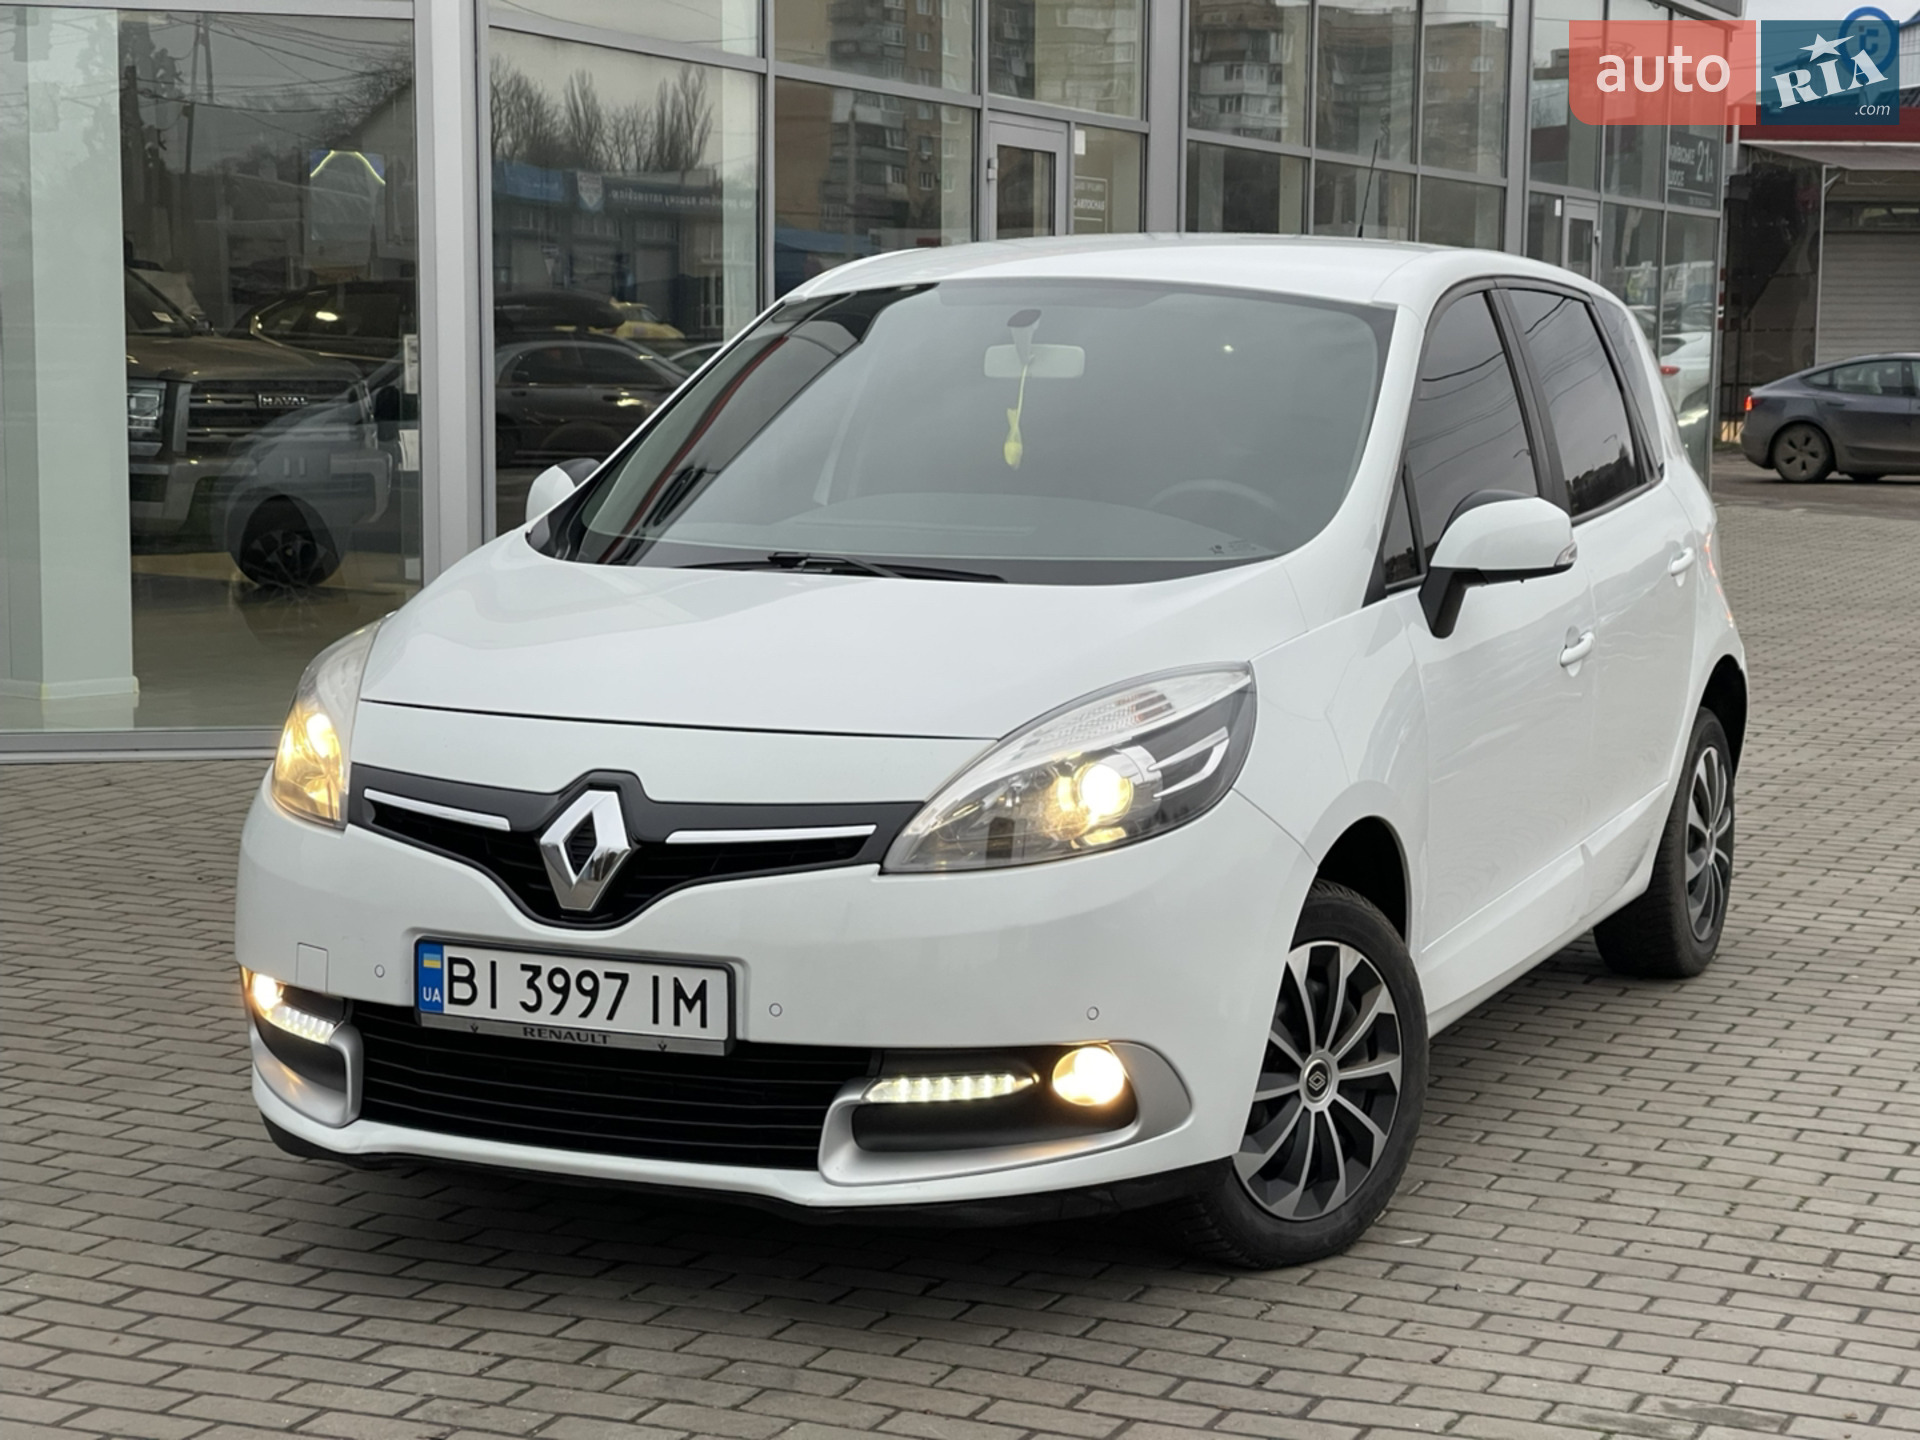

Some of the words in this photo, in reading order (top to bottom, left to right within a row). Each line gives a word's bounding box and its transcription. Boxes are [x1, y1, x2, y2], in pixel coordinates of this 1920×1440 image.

[262, 396, 308, 406] HAVAL
[423, 986, 441, 1003] UA
[447, 956, 497, 1010] BI
[519, 963, 630, 1021] 3997
[652, 975, 707, 1028] IM
[522, 1026, 611, 1045] RENAULT
